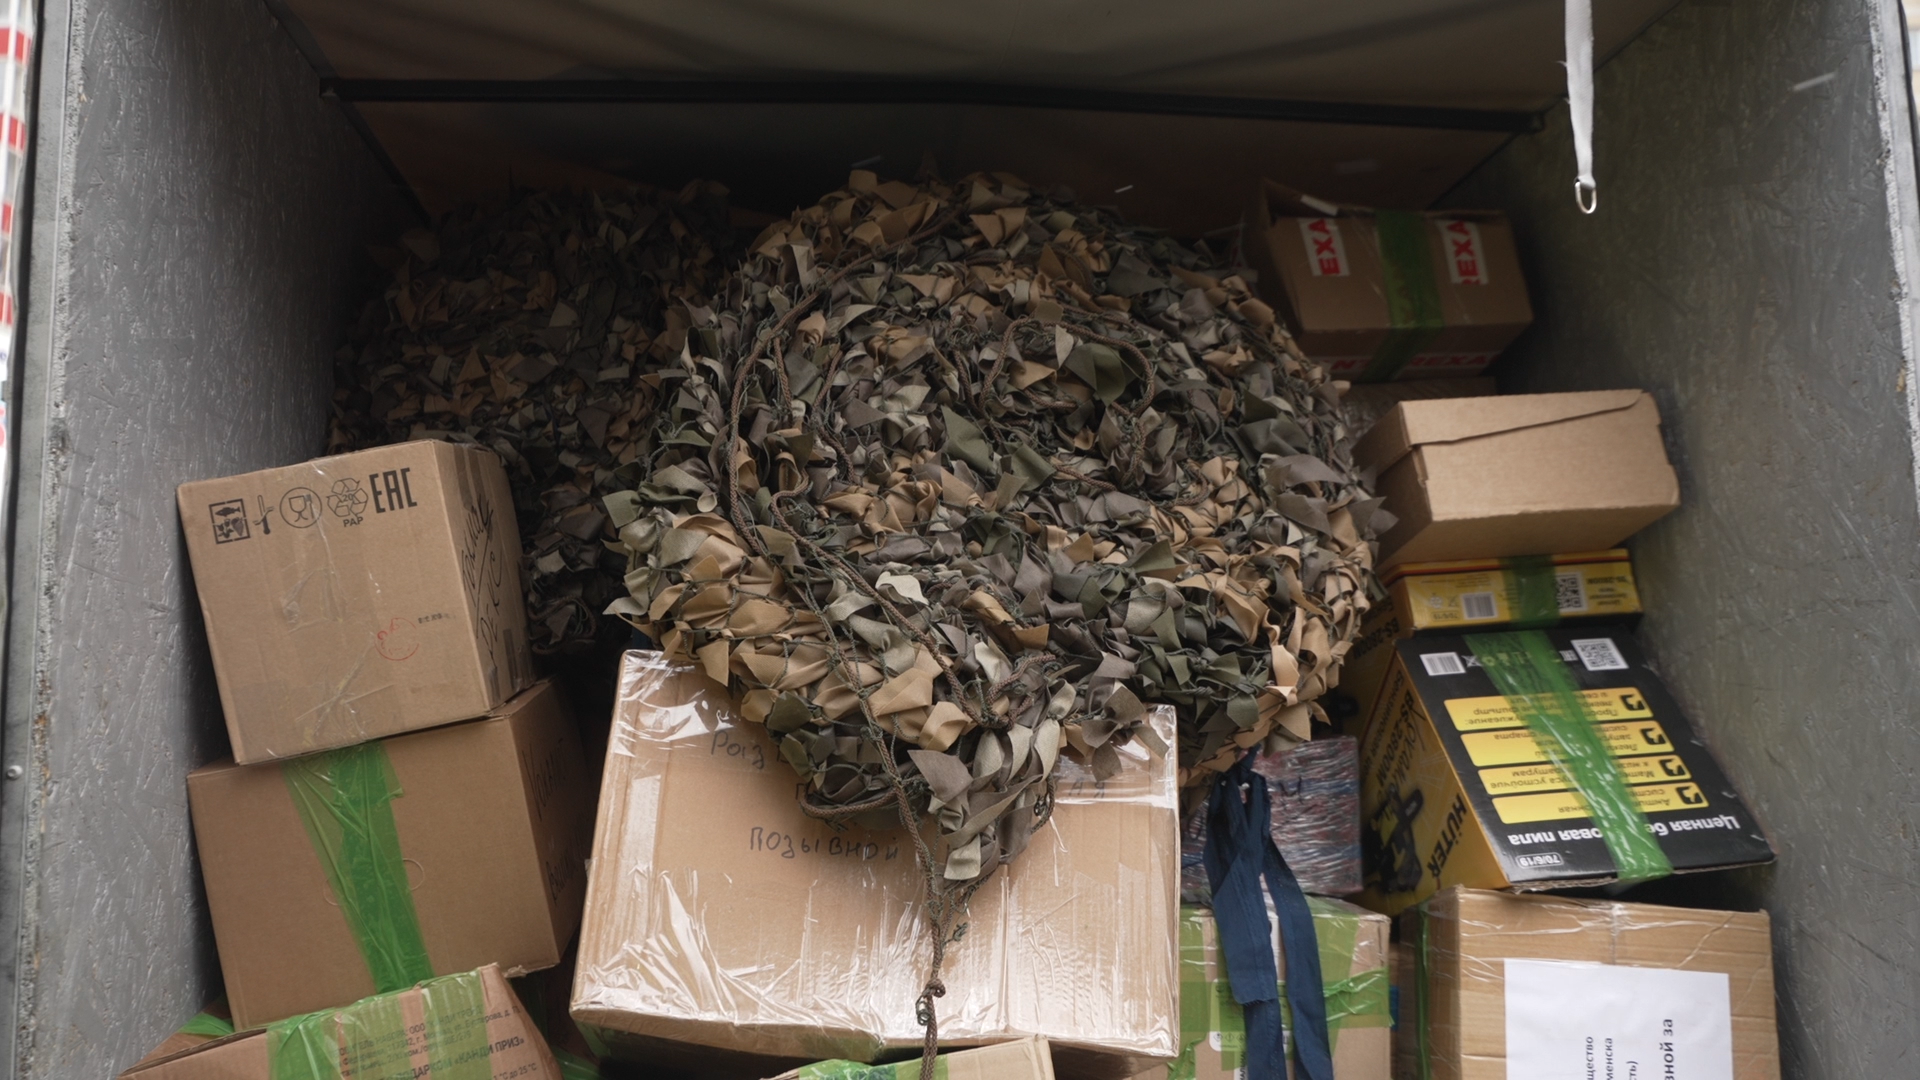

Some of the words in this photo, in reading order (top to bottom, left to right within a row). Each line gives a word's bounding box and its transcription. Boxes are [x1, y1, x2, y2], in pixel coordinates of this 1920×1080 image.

[343, 516, 364, 528] PAP
[1670, 814, 1741, 833] Цепная
[1427, 792, 1467, 878] HÜTER
[1508, 832, 1555, 847] пила
[1520, 854, 1561, 868] 70/6/19
[1662, 1018, 1674, 1037] за
[494, 1036, 525, 1053] ПРИЗ»
